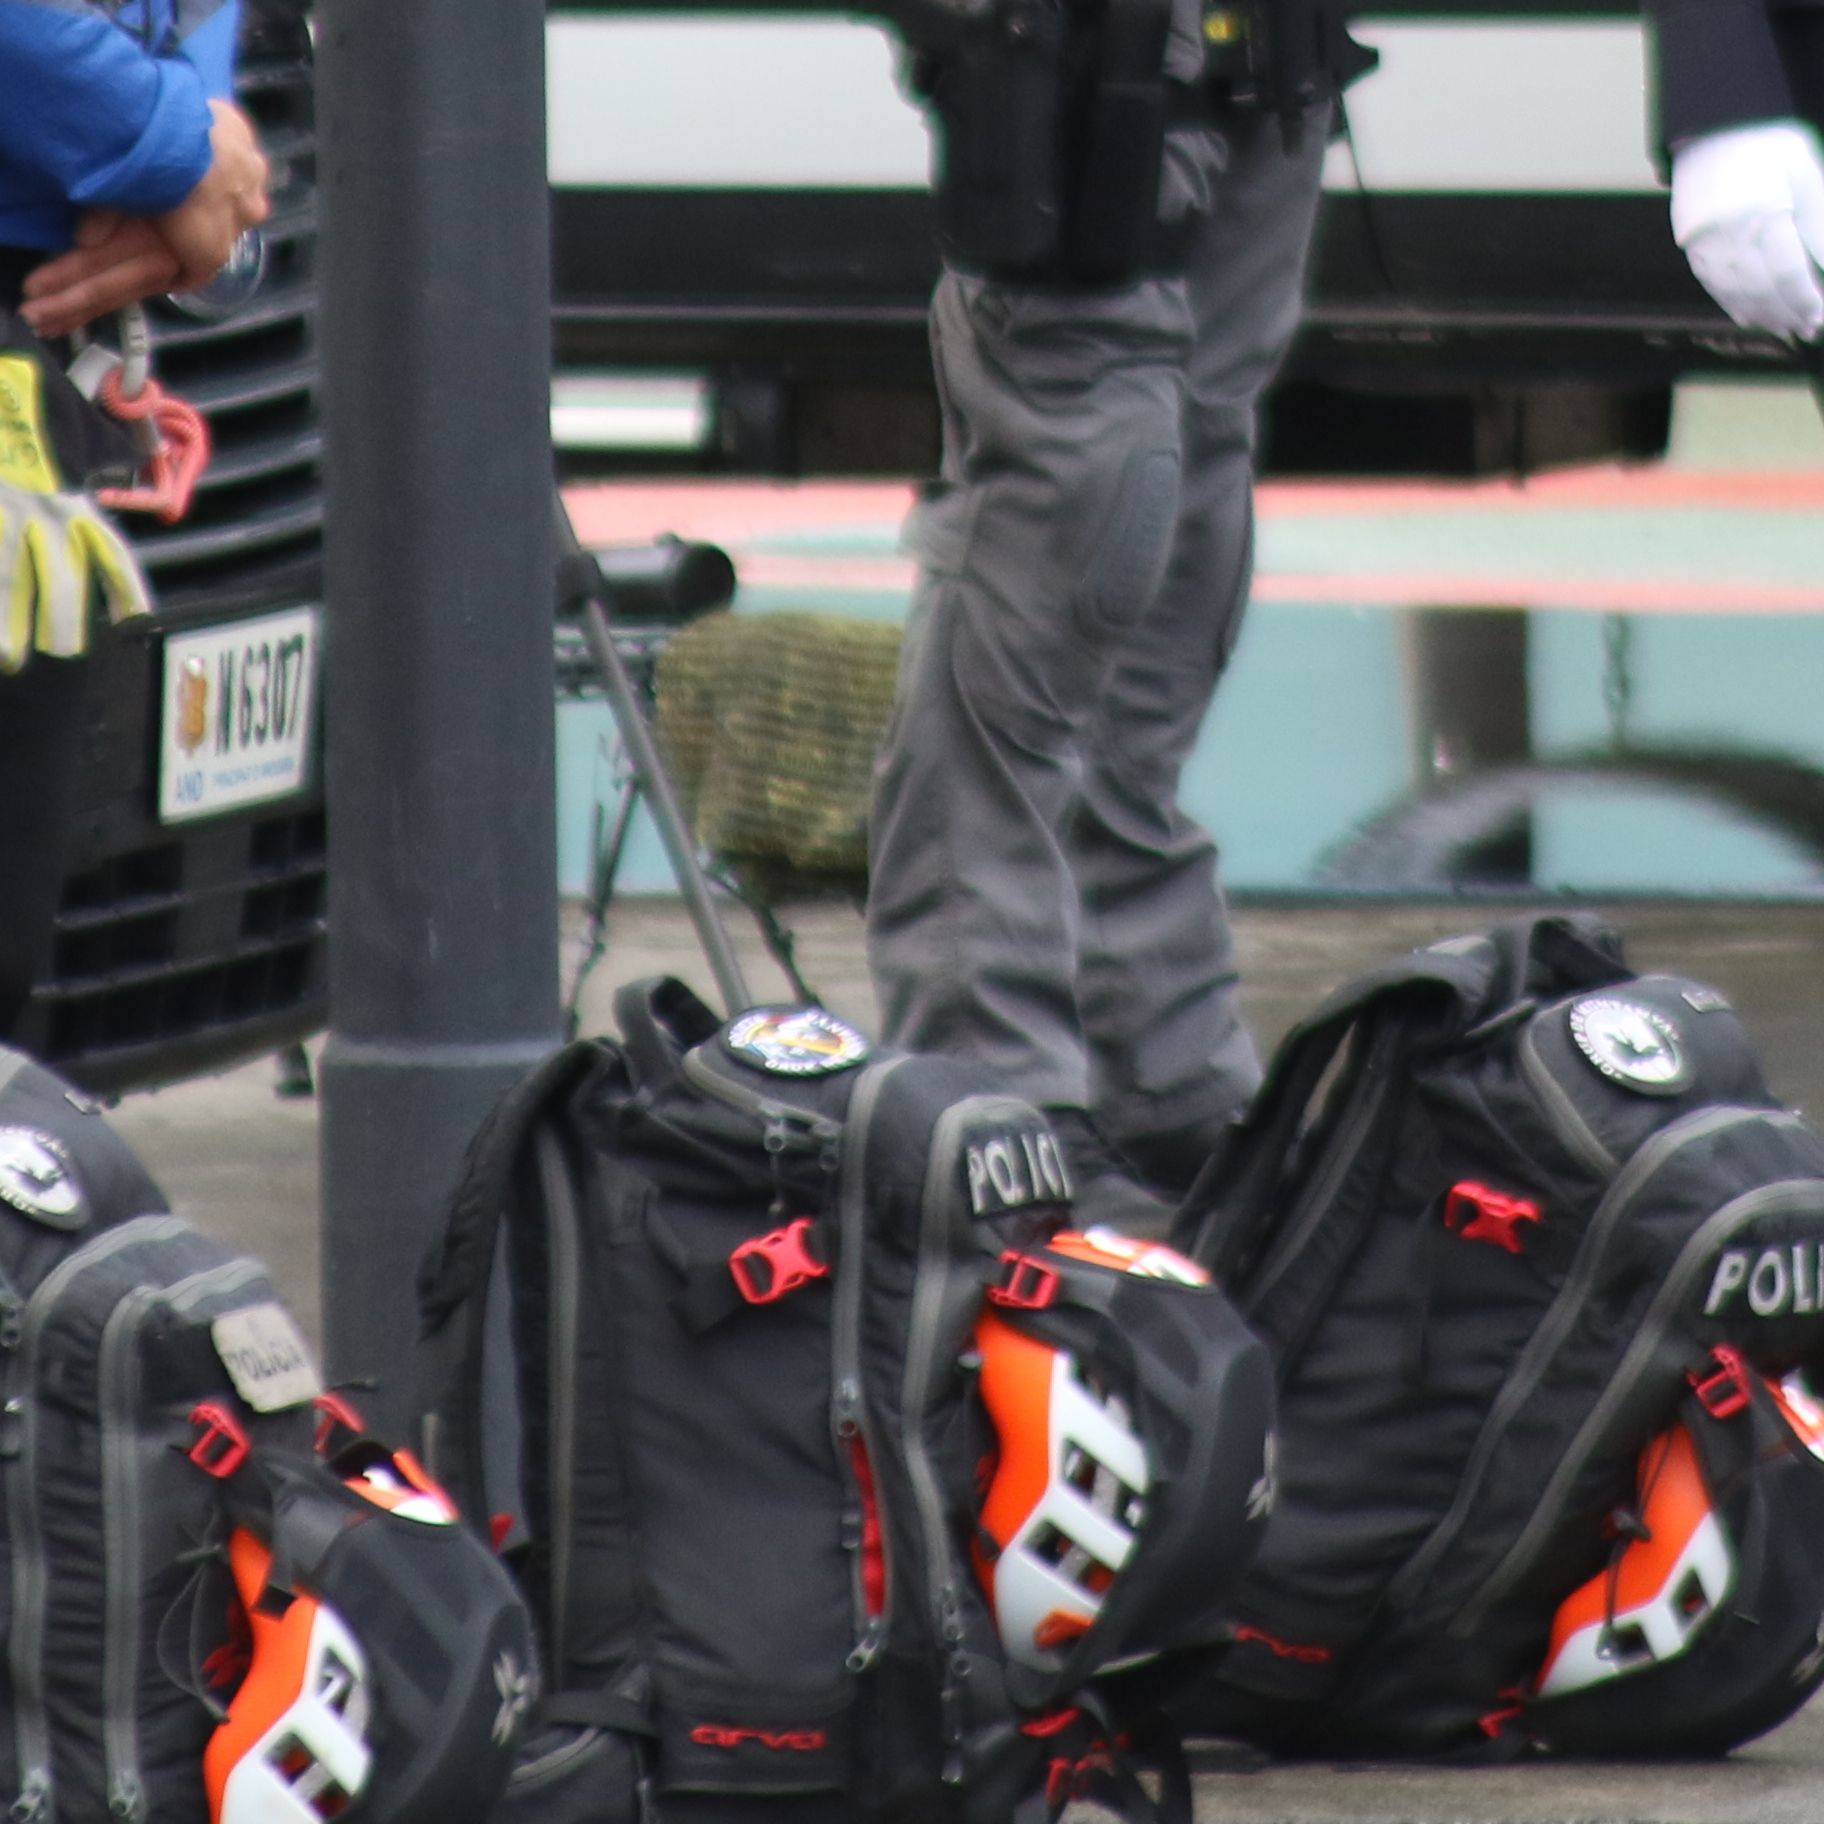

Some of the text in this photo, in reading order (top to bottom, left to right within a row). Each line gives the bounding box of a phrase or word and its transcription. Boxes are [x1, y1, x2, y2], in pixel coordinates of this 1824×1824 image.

[967, 1132, 1073, 1215] POLICI
[1235, 1625, 1333, 1665] rva
[690, 1724, 828, 1752] arva
